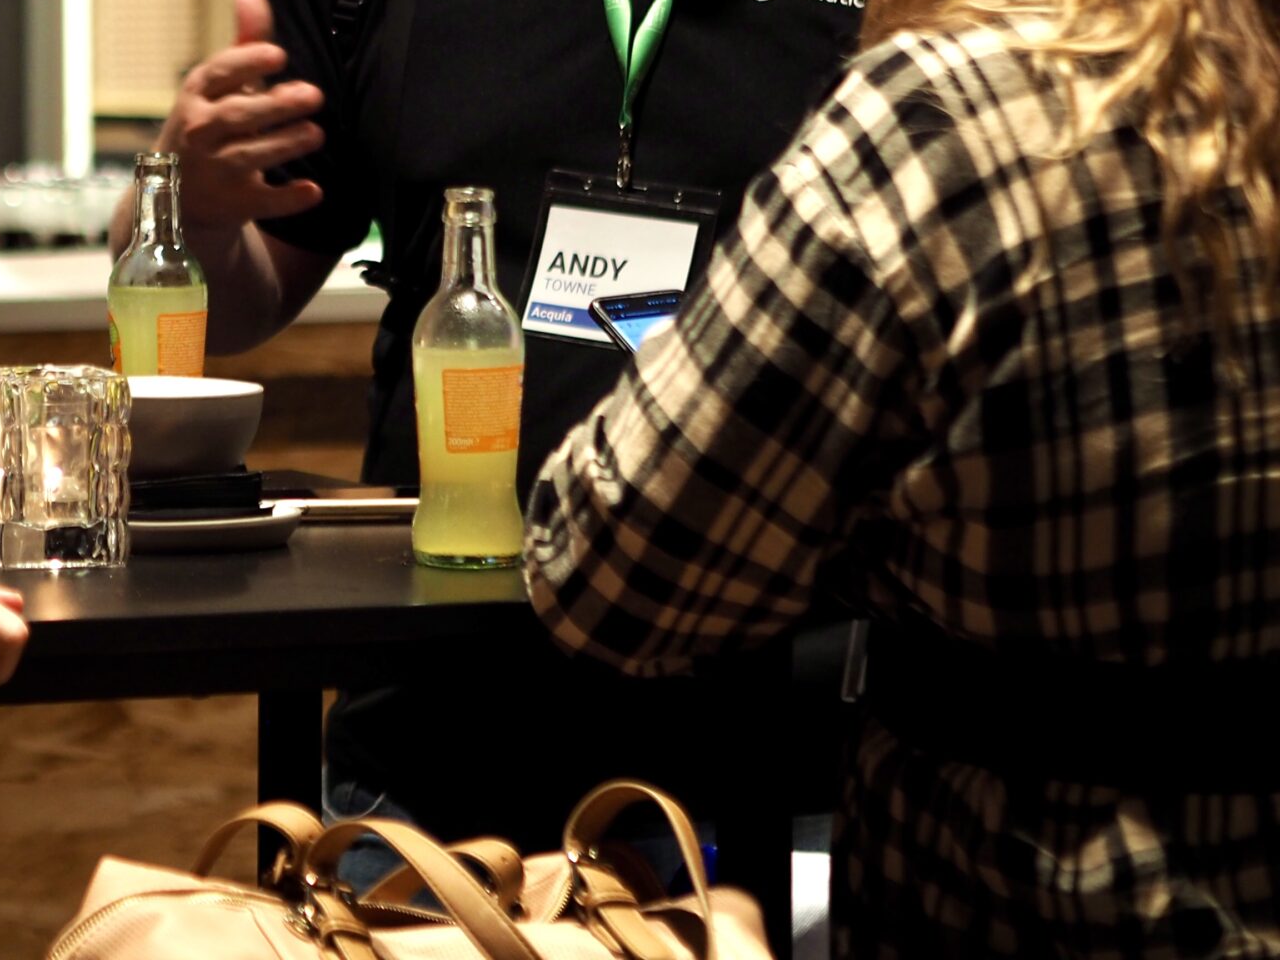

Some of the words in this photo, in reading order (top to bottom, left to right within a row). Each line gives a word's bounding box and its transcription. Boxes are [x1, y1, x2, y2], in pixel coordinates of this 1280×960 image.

[547, 251, 628, 281] ANDY
[544, 278, 597, 296] TOWNE
[531, 306, 573, 322] Acquia
